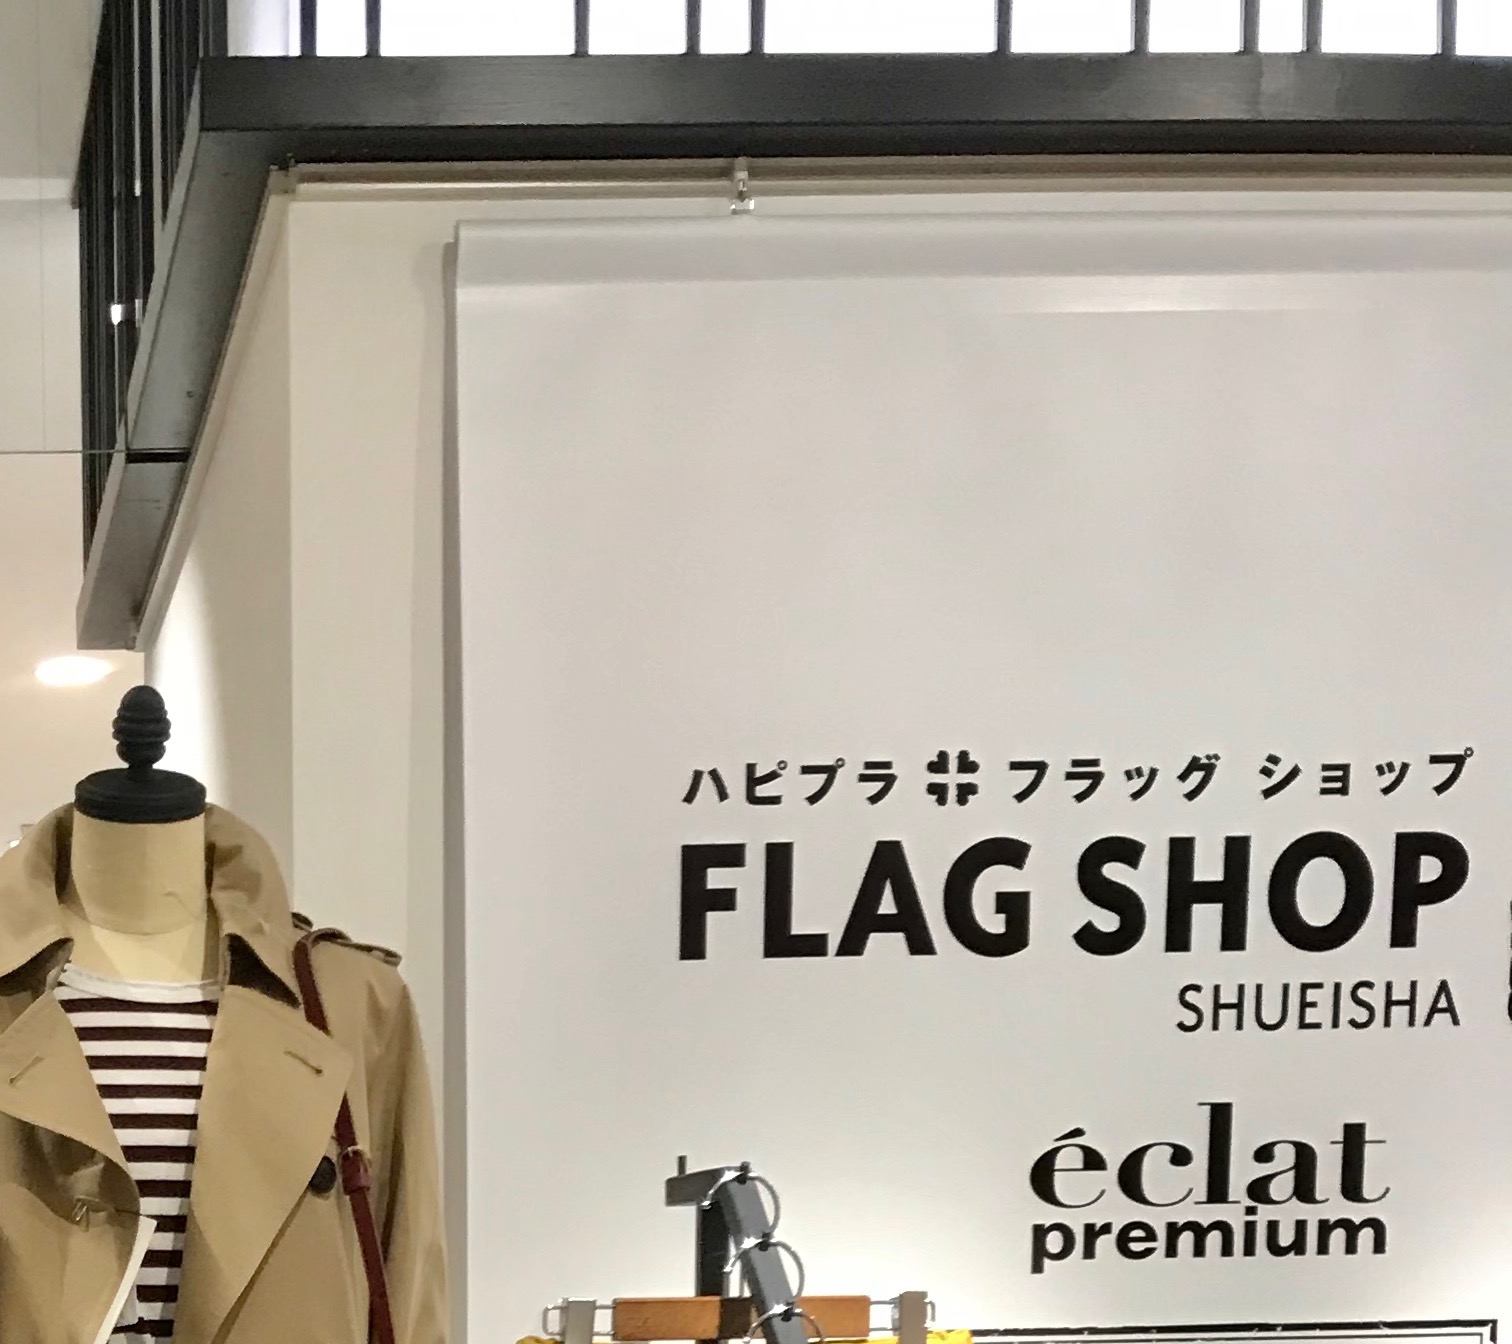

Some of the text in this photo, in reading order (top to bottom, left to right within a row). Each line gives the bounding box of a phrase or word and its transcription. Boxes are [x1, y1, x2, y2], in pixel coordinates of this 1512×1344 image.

[682, 746, 1474, 806] ハピプラ フラッグ ショップ
[679, 831, 1470, 960] FLAG SHOP
[1176, 978, 1461, 1033] SHUEISHA
[1029, 1101, 1391, 1208] éclat
[1030, 1205, 1388, 1274] premium
